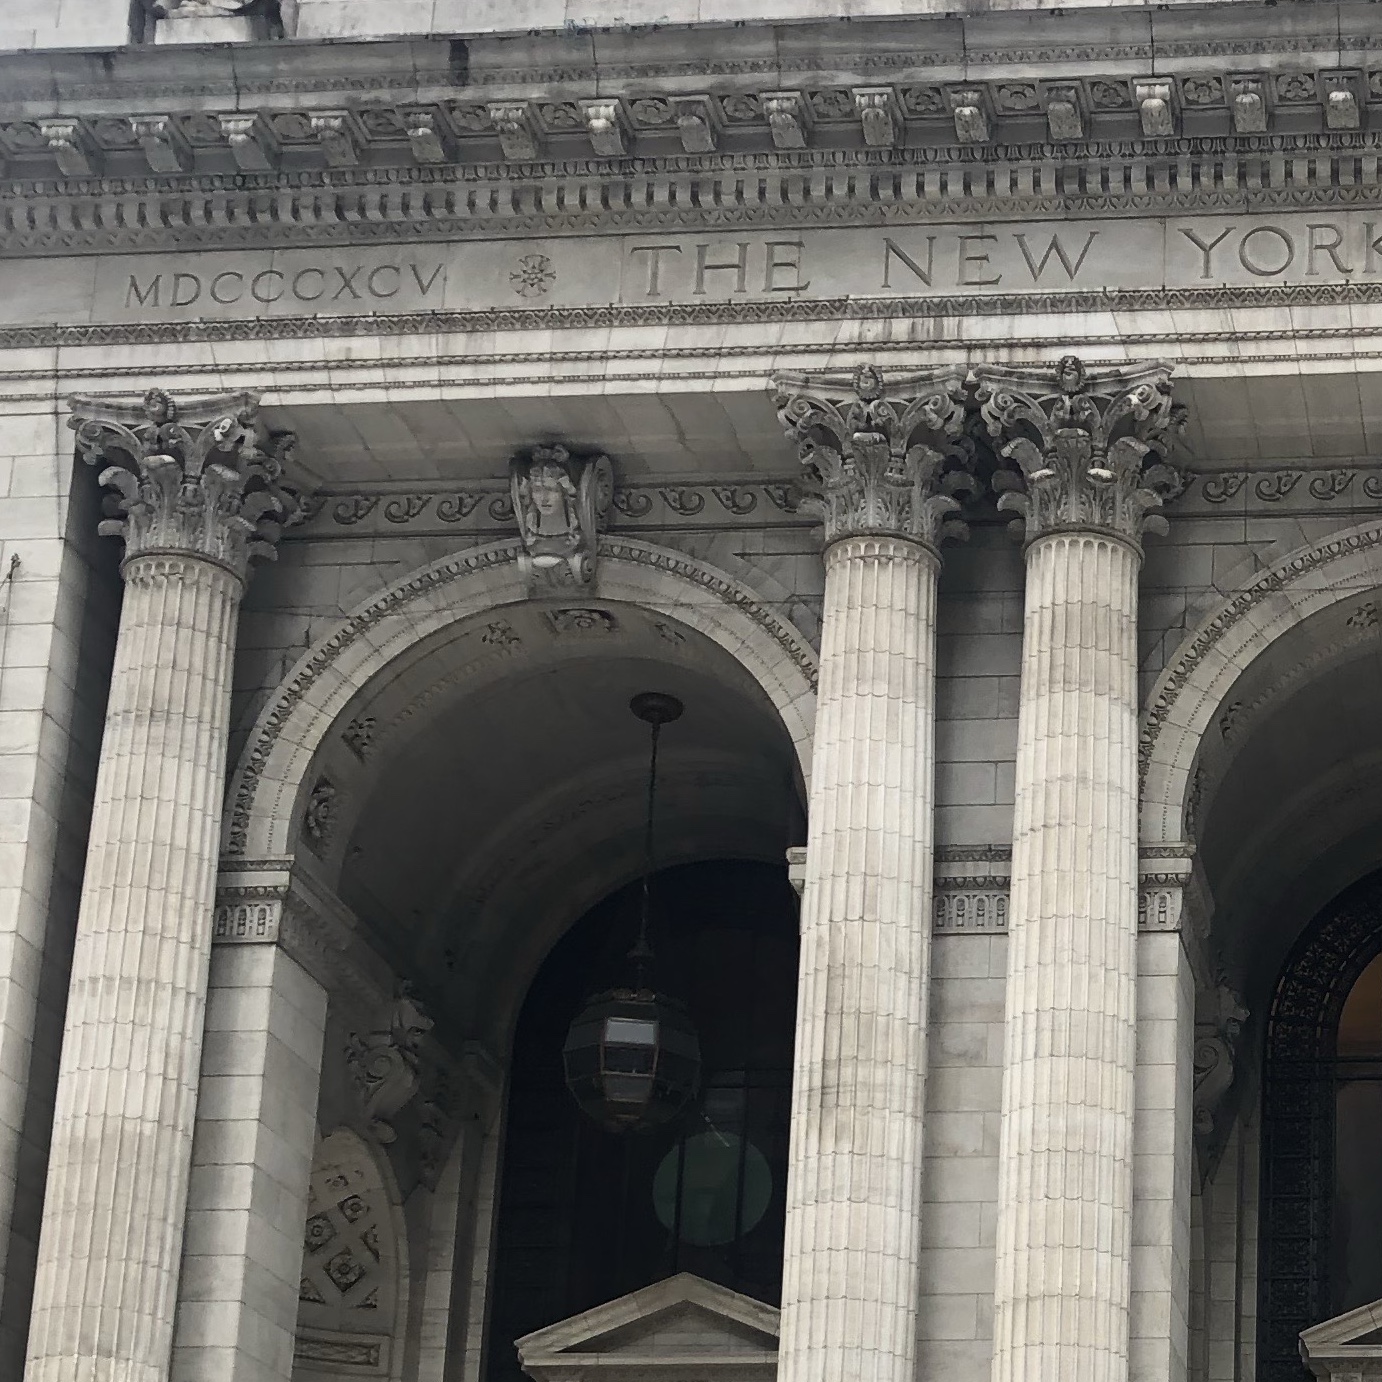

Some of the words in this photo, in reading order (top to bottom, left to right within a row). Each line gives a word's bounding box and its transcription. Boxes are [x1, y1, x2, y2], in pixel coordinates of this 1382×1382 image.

[126, 263, 444, 308] MDCCCXCV
[631, 240, 811, 297] THE
[881, 230, 1100, 288] NEW
